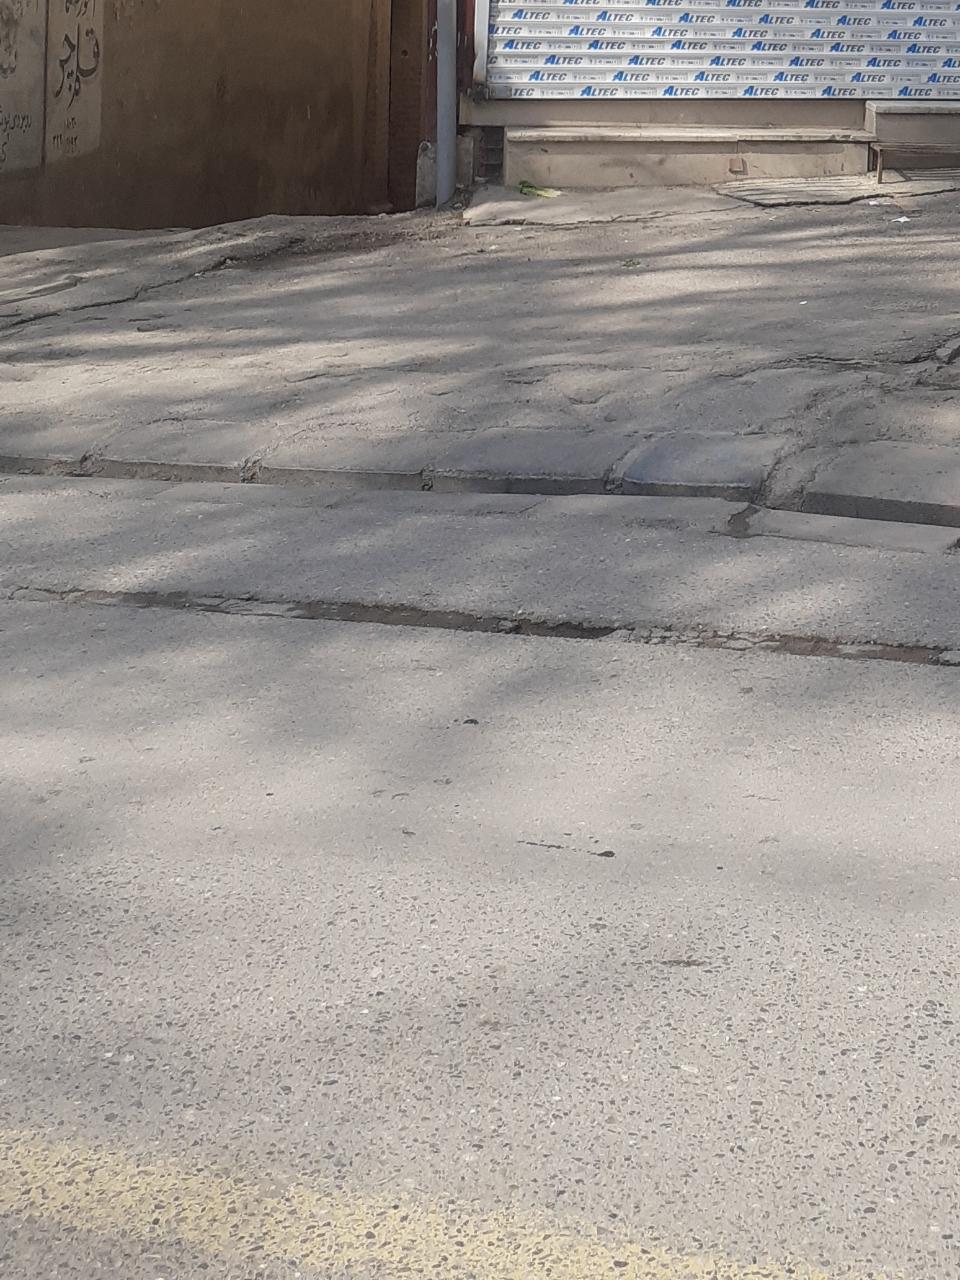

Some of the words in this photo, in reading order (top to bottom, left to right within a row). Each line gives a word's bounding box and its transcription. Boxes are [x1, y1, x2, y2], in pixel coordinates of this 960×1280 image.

[512, 8, 551, 21] ALTEC
[836, 14, 872, 27] ALTEC
[568, 24, 607, 37] ALTEC
[732, 26, 768, 38] ALTEC
[906, 43, 942, 55] ALTEC
[529, 70, 568, 82] ALTEC
[580, 85, 619, 97] ALTEC
[662, 85, 701, 97] ALTEC
[743, 85, 779, 97] ALTEC
[821, 85, 857, 97] ALTEC
[898, 86, 933, 97] ALTEC
